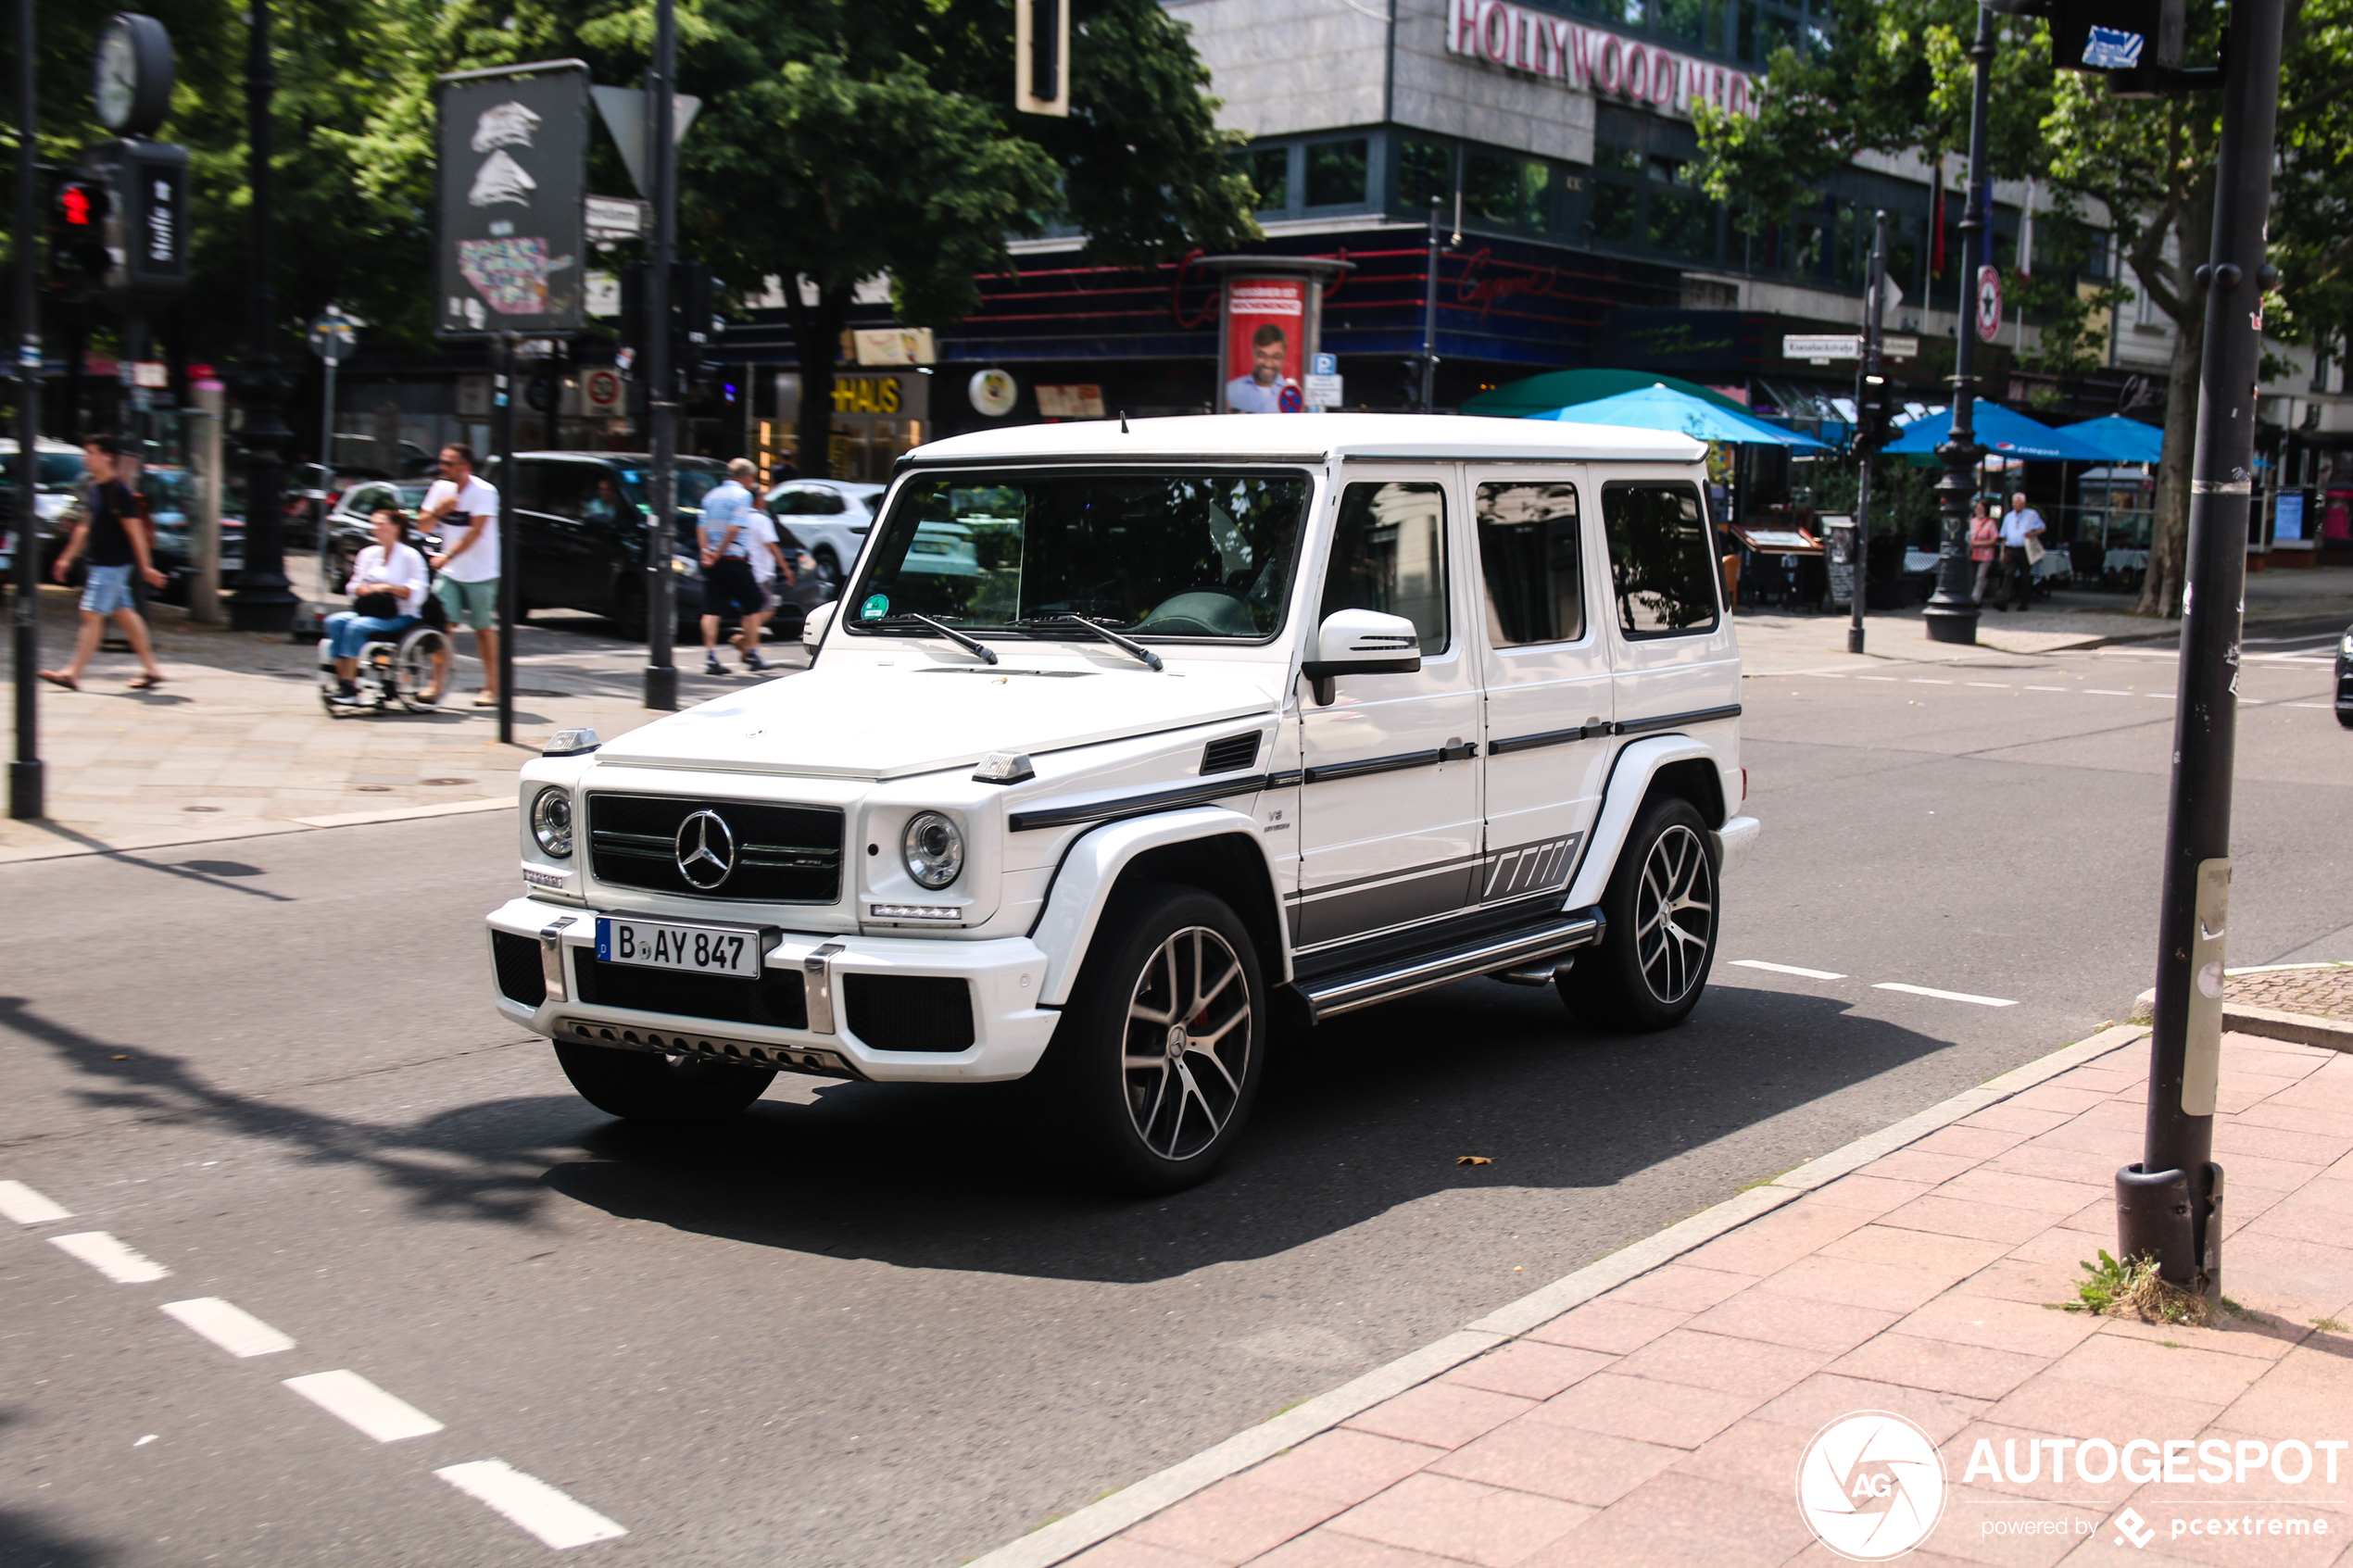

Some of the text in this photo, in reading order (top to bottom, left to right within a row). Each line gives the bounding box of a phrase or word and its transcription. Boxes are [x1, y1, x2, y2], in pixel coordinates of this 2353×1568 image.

[1449, 0, 1674, 106] HOLLYWOOD
[1316, 357, 1332, 374] P
[830, 377, 900, 414] HAUS
[872, 597, 880, 609] 4
[600, 944, 607, 954] D
[619, 925, 745, 970] B AY 847
